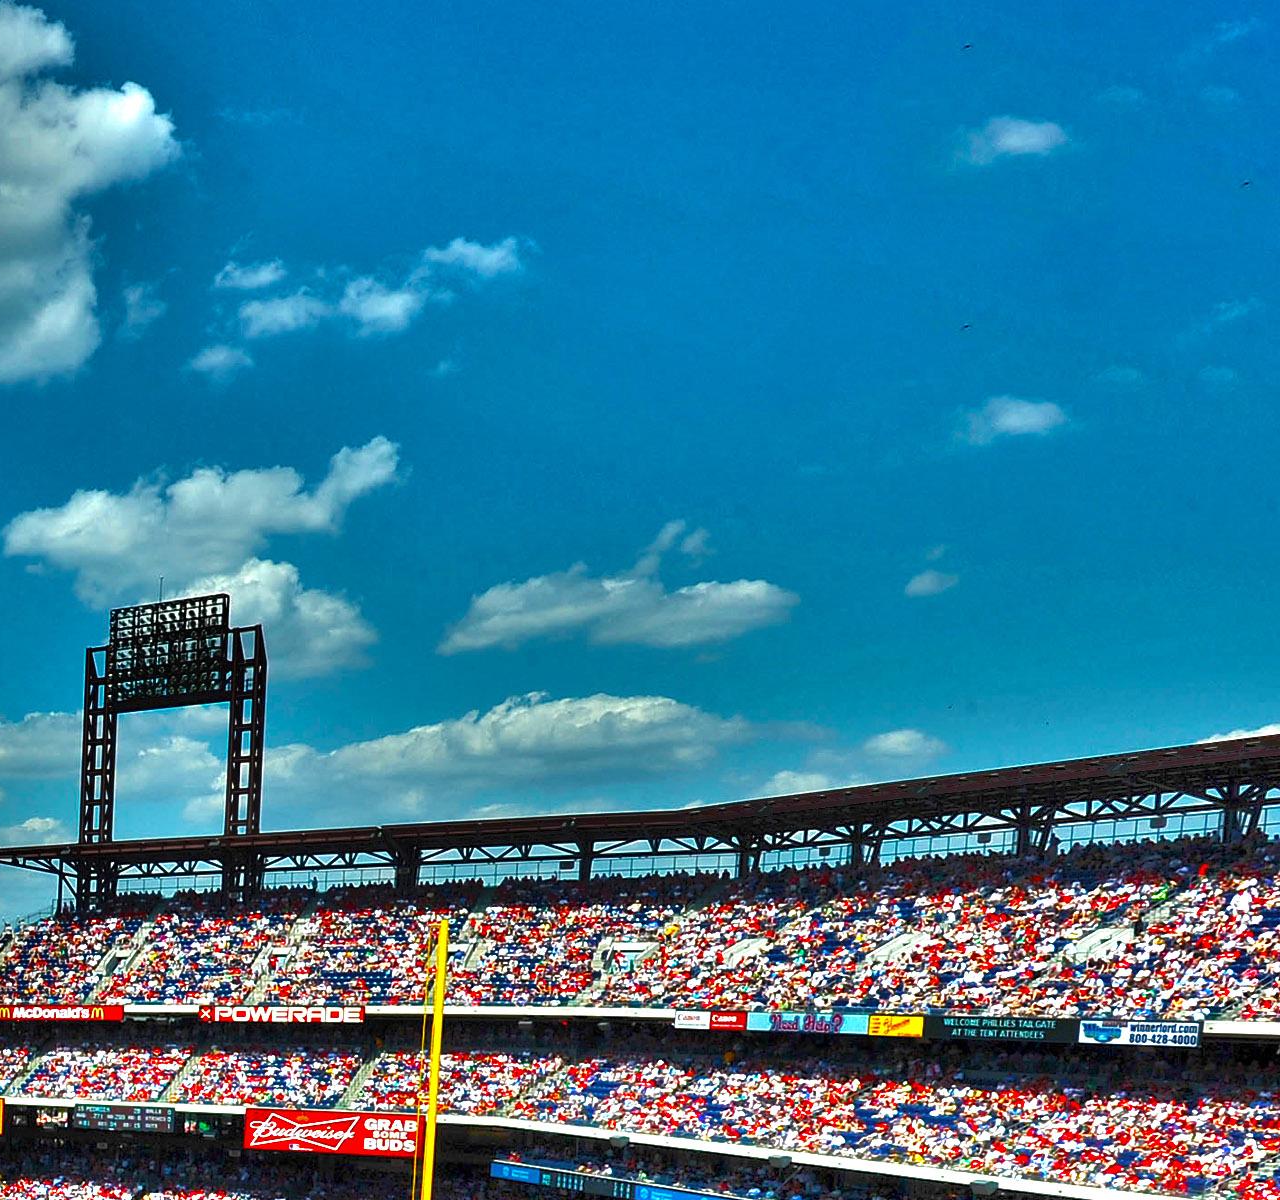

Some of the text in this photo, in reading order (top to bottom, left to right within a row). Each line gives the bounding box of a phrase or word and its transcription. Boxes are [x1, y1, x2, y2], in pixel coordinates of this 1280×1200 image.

[12, 1006, 90, 1020] McDonald's
[214, 1006, 362, 1023] POWERADE
[677, 1013, 701, 1022] Canon
[711, 1014, 738, 1023] Canon
[770, 1014, 799, 1032] Need
[943, 1017, 980, 1028] WELCOME
[981, 1018, 1016, 1028] PHILLIES
[1129, 1022, 1199, 1034] winnerford.com
[951, 1028, 1045, 1040] AT THE TENT ATTENDEES
[1128, 1034, 1198, 1046] 800-428-4000
[249, 1120, 355, 1140] Budweiser
[363, 1118, 418, 1132] GRAB
[372, 1130, 408, 1140] SOME
[363, 1136, 417, 1152] BUDS
